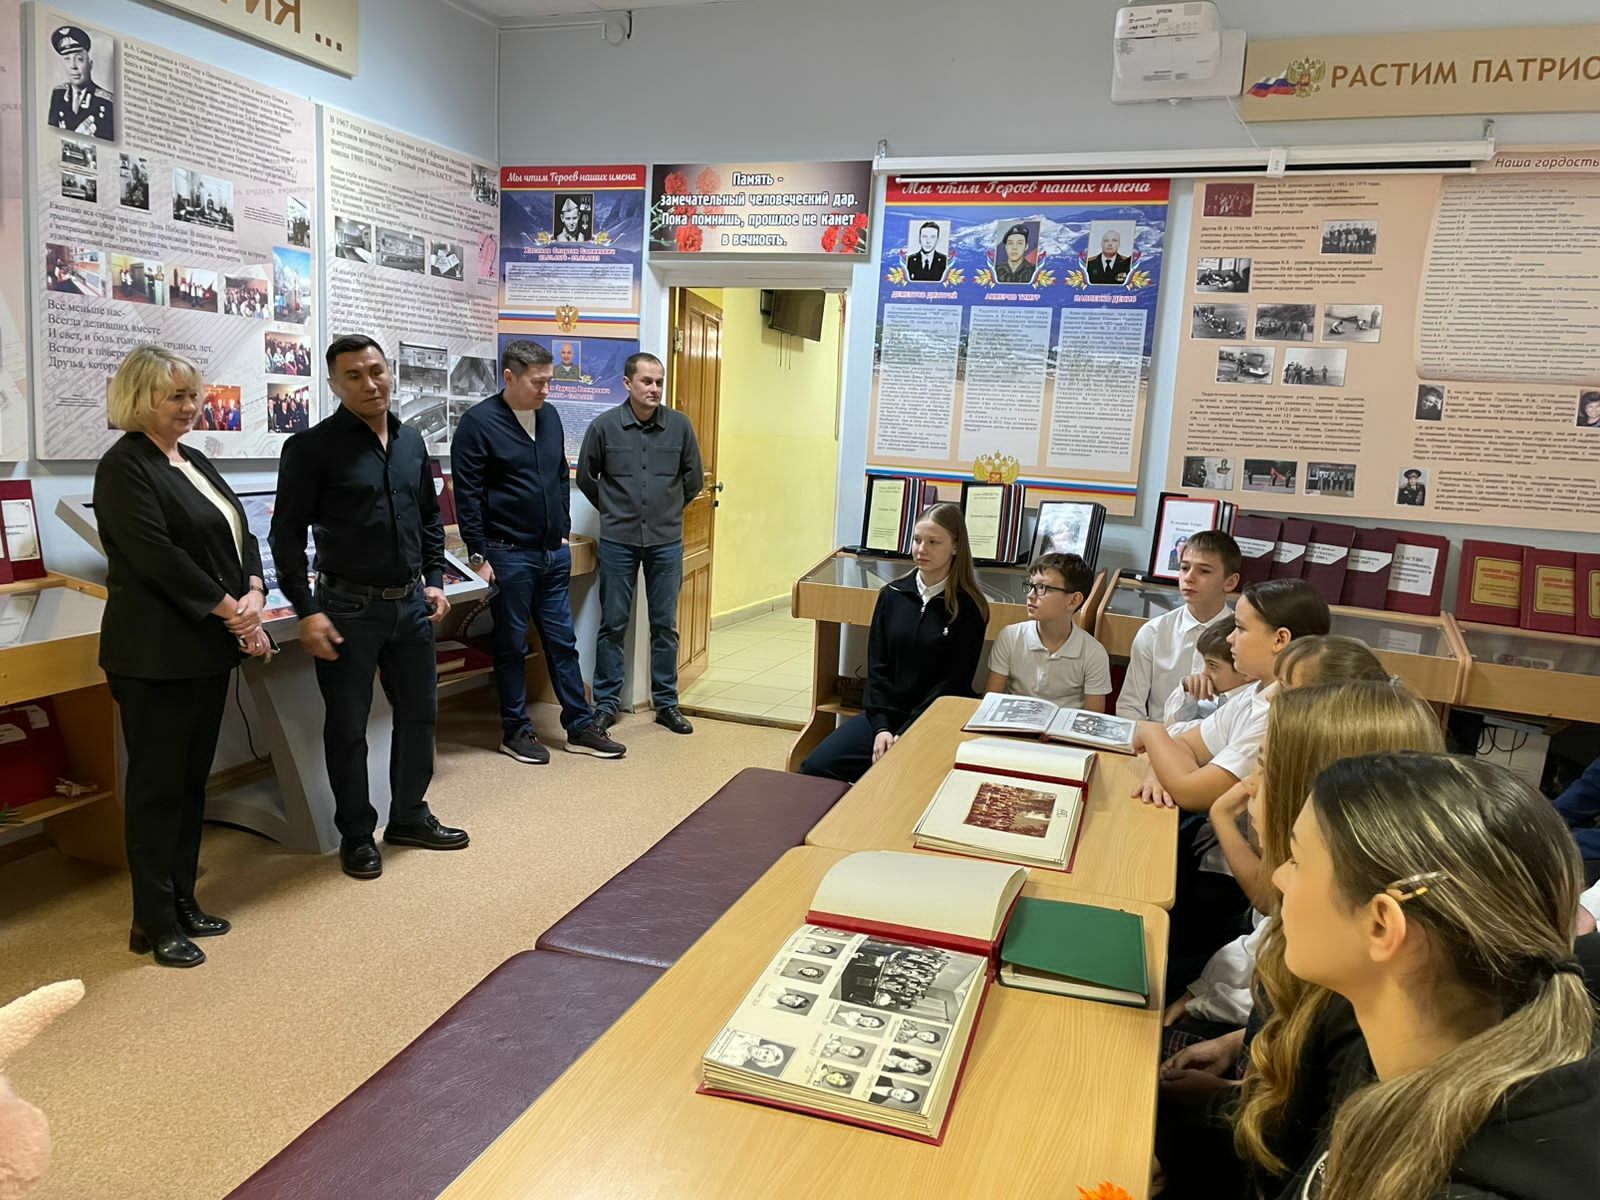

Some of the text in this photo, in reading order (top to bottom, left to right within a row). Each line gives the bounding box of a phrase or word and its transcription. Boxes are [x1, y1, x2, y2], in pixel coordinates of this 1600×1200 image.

[1331, 55, 1600, 88] РАСТИМ ПАТРИО
[1495, 156, 1600, 171] Наша гордость
[507, 170, 637, 185] Мы чтим Героев наших имена
[732, 172, 774, 186] Память
[902, 181, 1151, 199] Мы чтим Героев наших имена
[660, 191, 859, 208] замечательный человеческий дар.
[661, 212, 856, 228] Пока помнишь, прошлое не канет
[721, 234, 788, 247] в вечность.
[48, 314, 81, 326] Всегда
[132, 326, 161, 335] вместе
[48, 328, 56, 338] И
[48, 343, 85, 354] Встают
